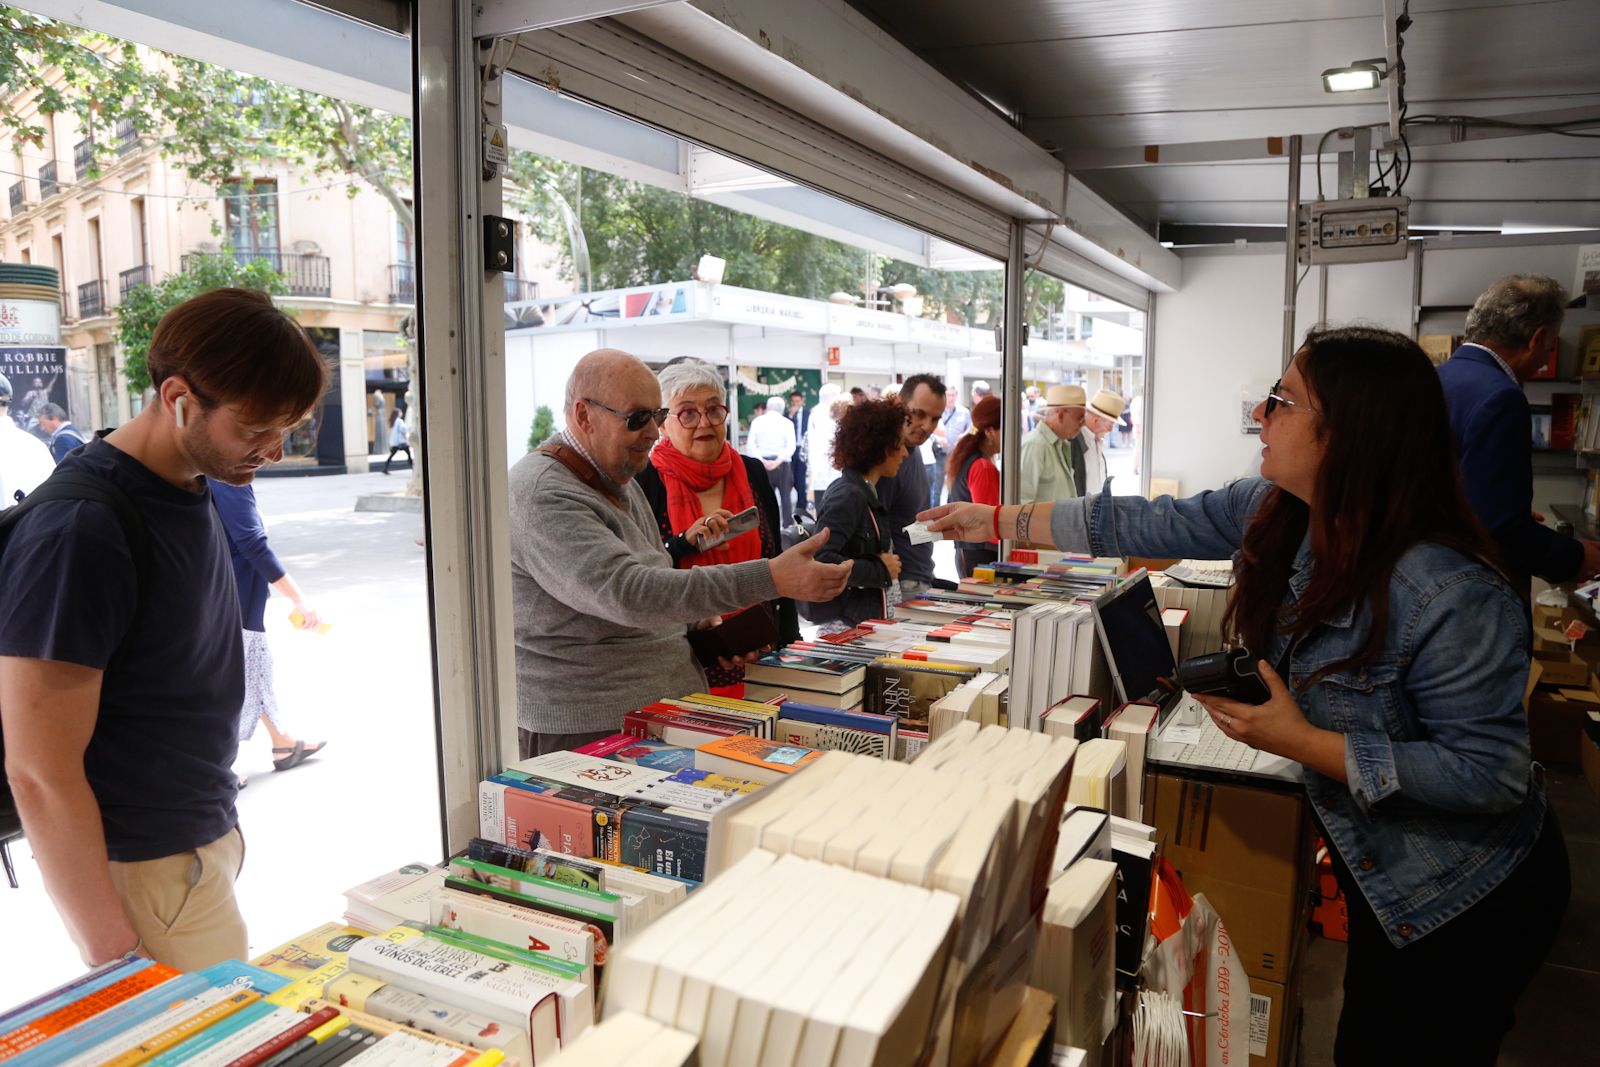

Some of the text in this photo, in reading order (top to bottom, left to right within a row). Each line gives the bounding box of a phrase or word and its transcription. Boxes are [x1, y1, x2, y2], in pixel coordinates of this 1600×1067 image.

[4, 352, 57, 363] ROBBIE
[897, 686, 910, 717] RUT
[374, 945, 463, 979] VINOS DE JEREZ
[1216, 966, 1230, 996] 1919
[1216, 998, 1230, 1048] Córdoba
